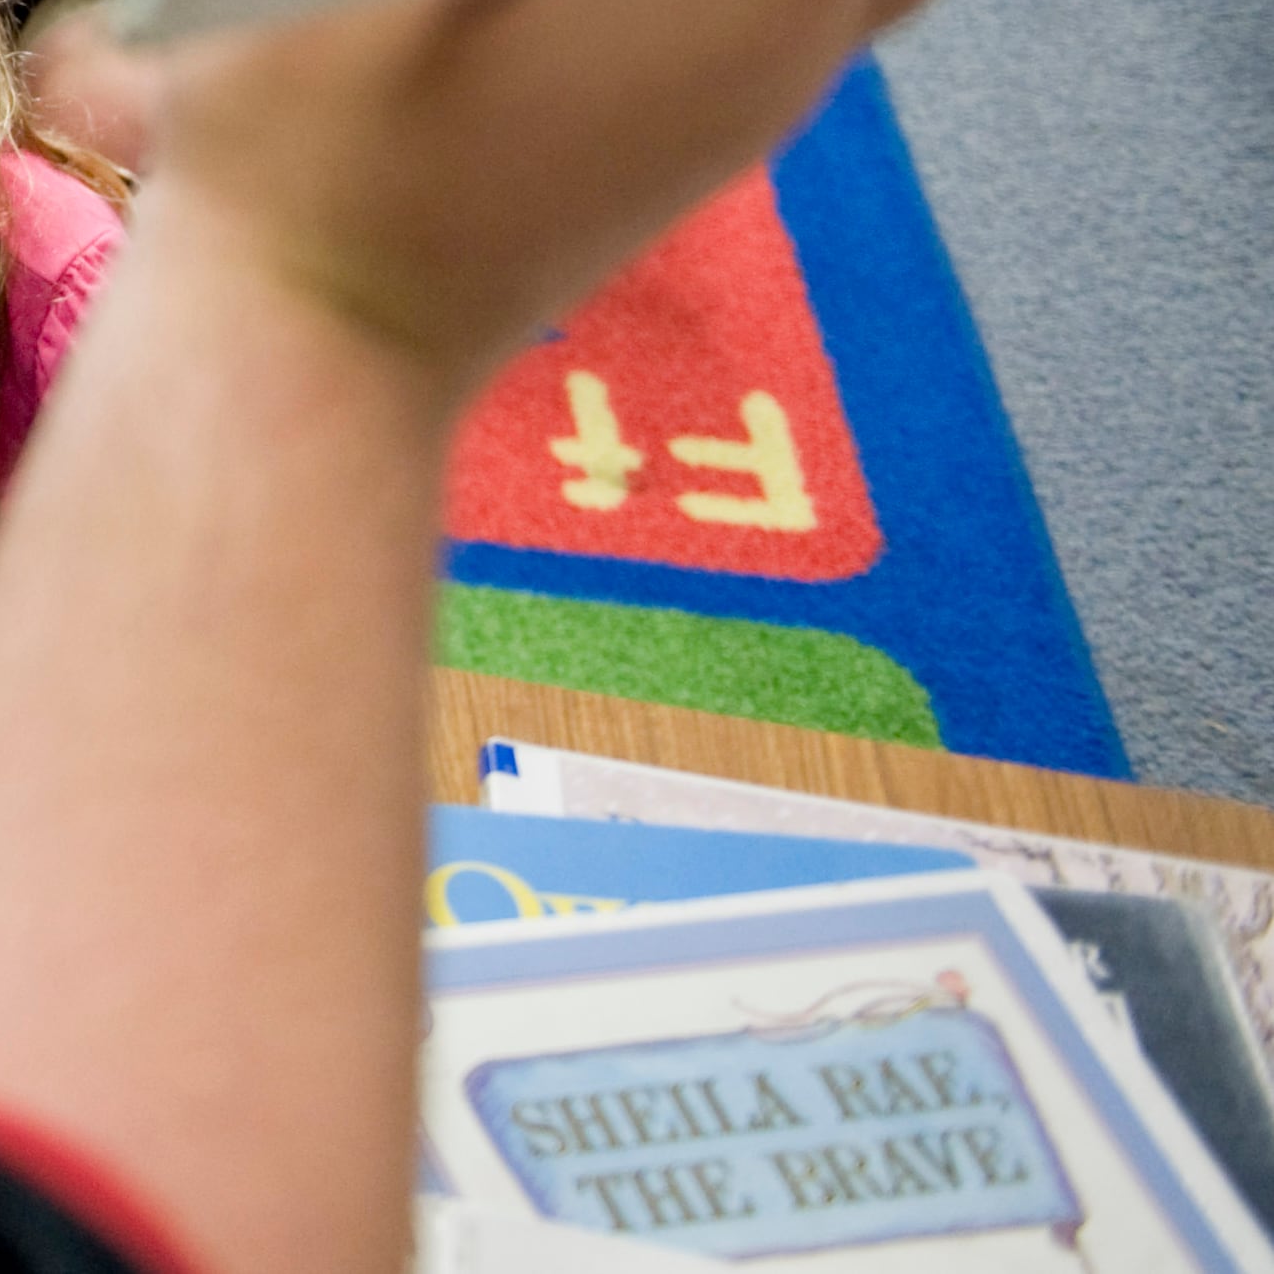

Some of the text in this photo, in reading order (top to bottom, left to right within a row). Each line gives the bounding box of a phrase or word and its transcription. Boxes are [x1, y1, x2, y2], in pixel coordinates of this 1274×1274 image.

[508, 1049, 1013, 1160] SHEILA RAE,
[575, 1125, 1031, 1233] THE BRAVE
